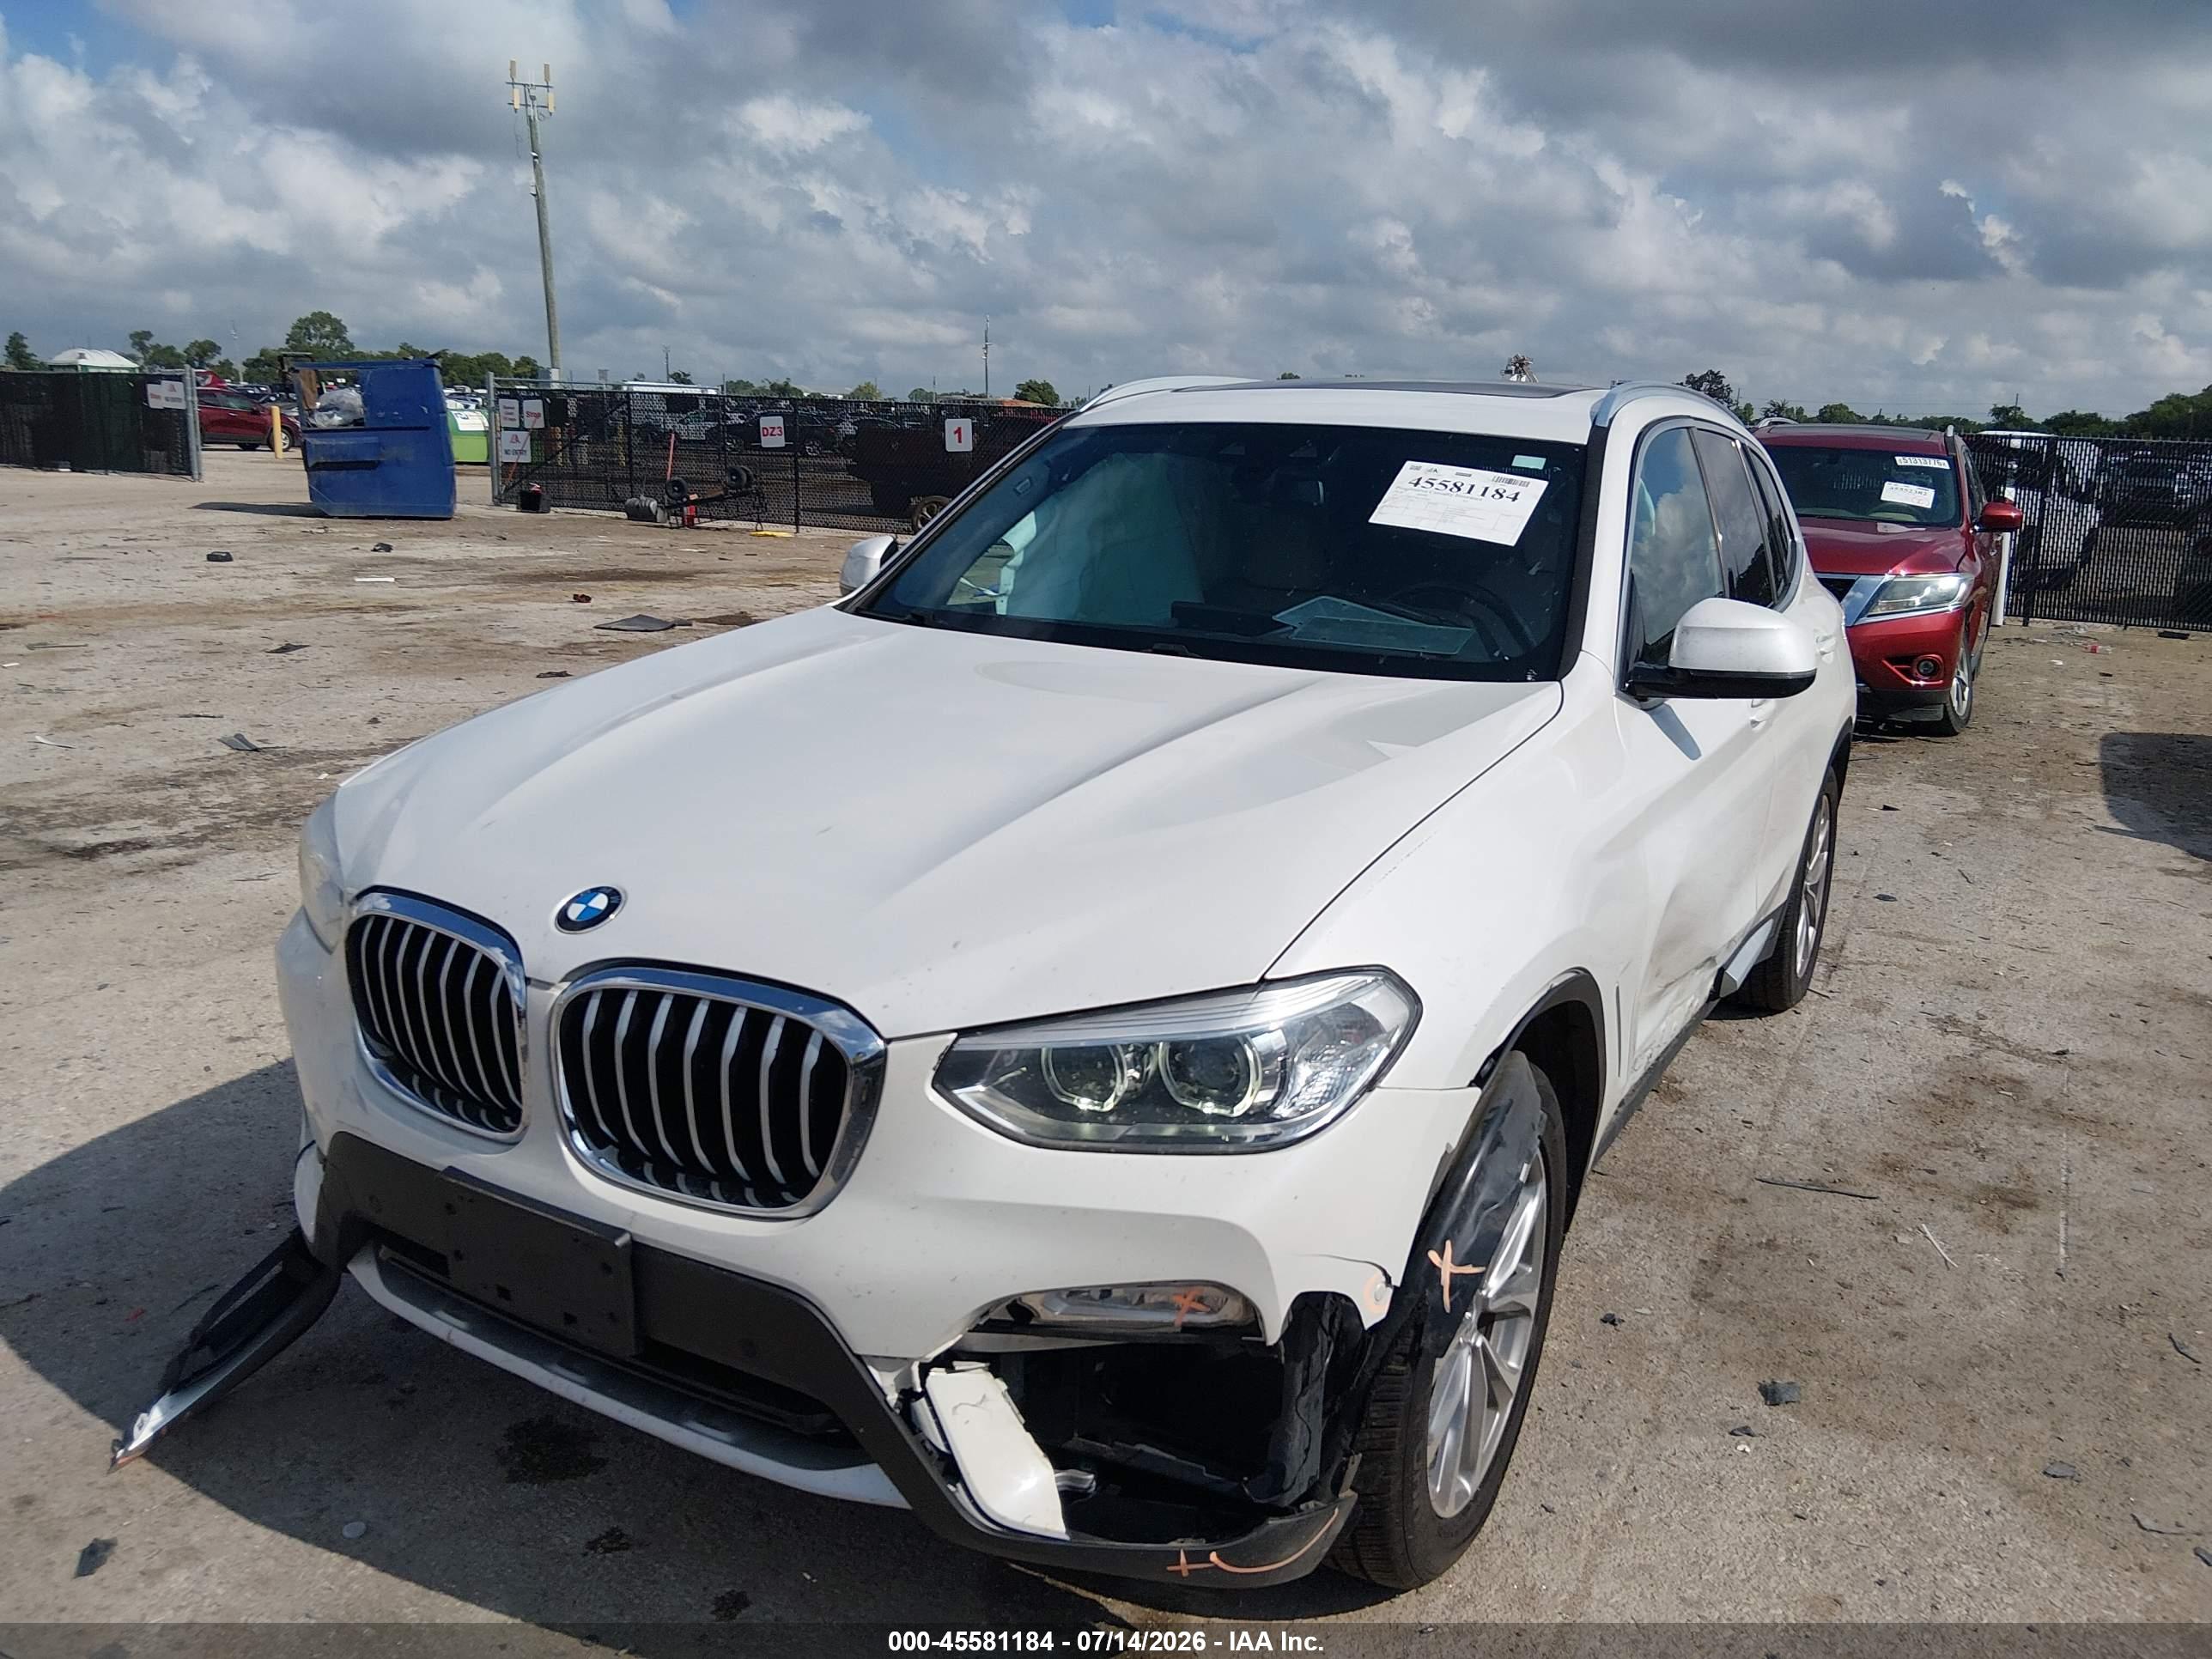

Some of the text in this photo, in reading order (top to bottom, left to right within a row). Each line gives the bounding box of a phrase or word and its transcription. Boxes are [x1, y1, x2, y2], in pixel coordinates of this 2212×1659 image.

[762, 426, 783, 437] DZ3
[953, 426, 963, 444] 1
[1408, 476, 1522, 502] 45581184
